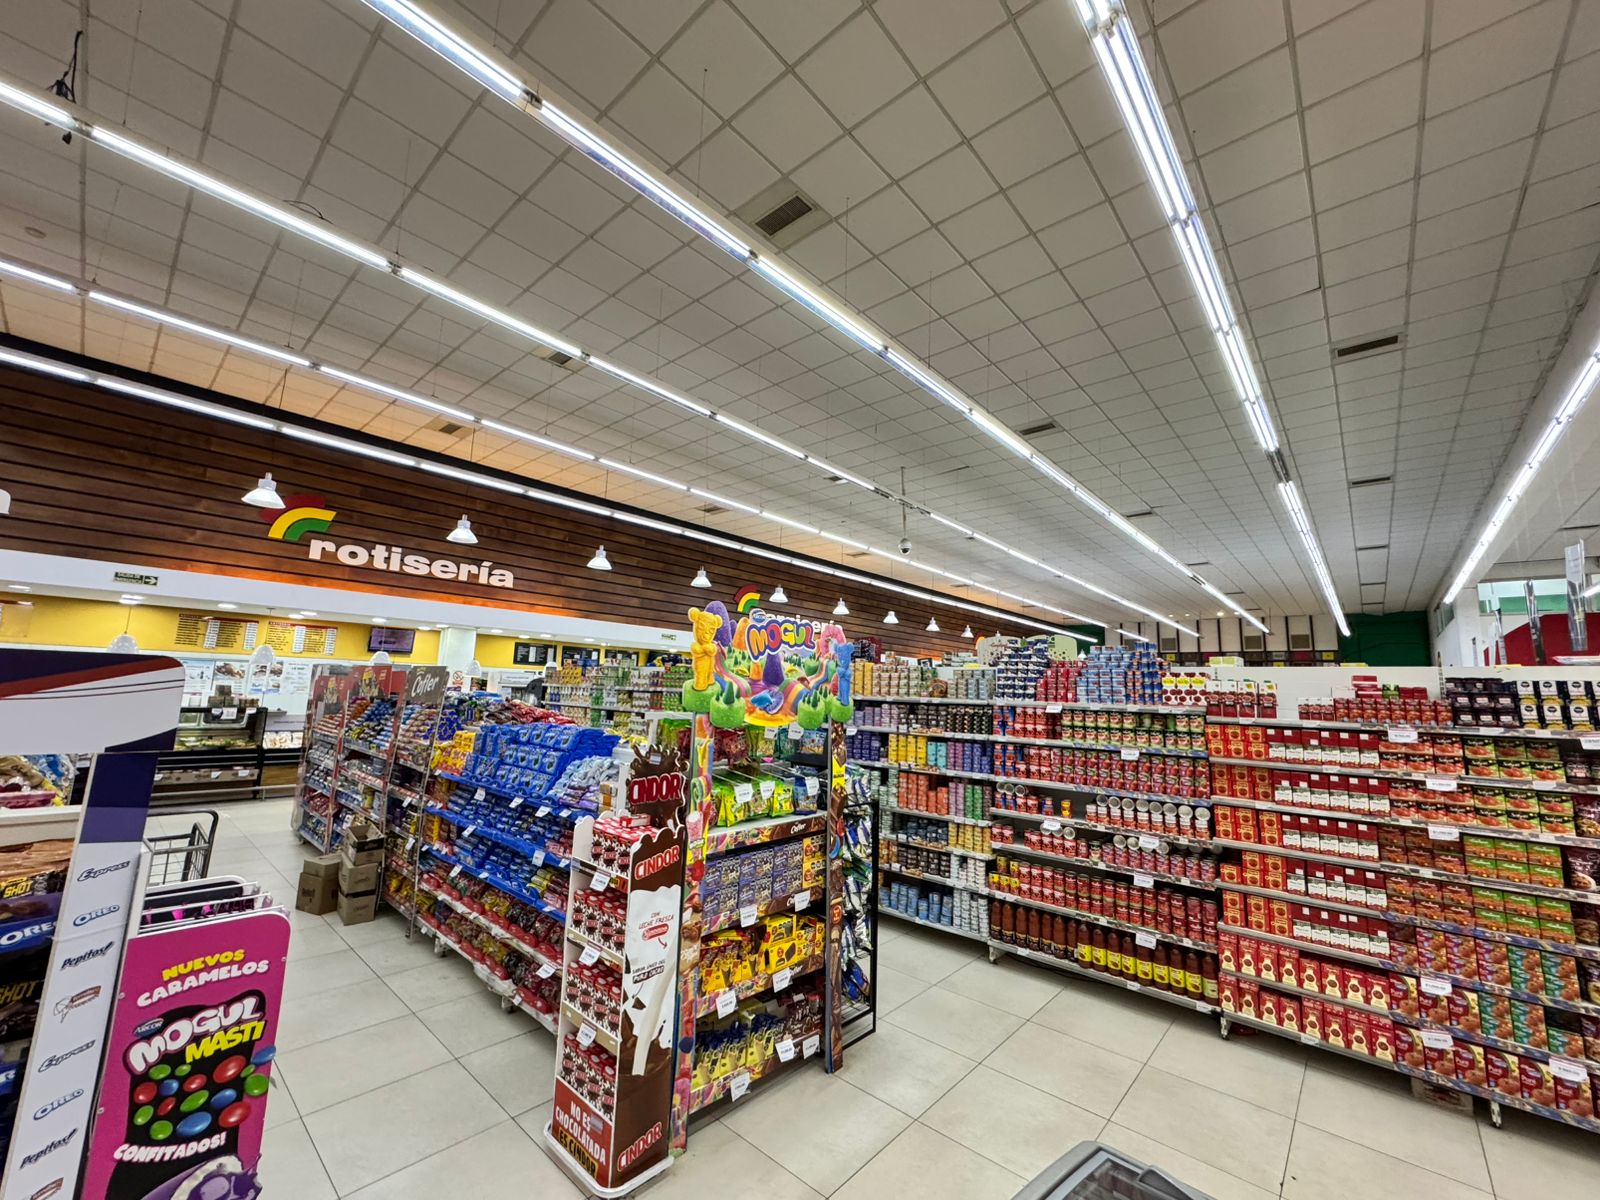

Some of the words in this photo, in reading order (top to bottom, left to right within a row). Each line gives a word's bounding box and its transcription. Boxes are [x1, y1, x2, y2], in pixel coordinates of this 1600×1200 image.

[308, 539, 514, 588] rotisería
[748, 621, 815, 657] MOGUL
[629, 771, 682, 805] CINDOR
[634, 845, 680, 881] CINDOR
[4, 881, 34, 899] SHOT
[0, 919, 57, 946] ORE
[73, 904, 120, 927] OREO
[162, 949, 246, 981] NUEVOS
[136, 959, 270, 1008] CARAMELOS
[128, 997, 264, 1073] MOGUL
[185, 1021, 266, 1064] MASTI
[33, 1089, 84, 1120] OREO
[570, 1100, 581, 1120] NO
[582, 1111, 592, 1132] ES
[113, 1131, 228, 1164] CONFITADOS!
[555, 1105, 607, 1167] CHOCOLATADA
[559, 1128, 568, 1148] ES
[569, 1138, 597, 1176] CINDOR
[617, 1122, 663, 1172] CINDOR
